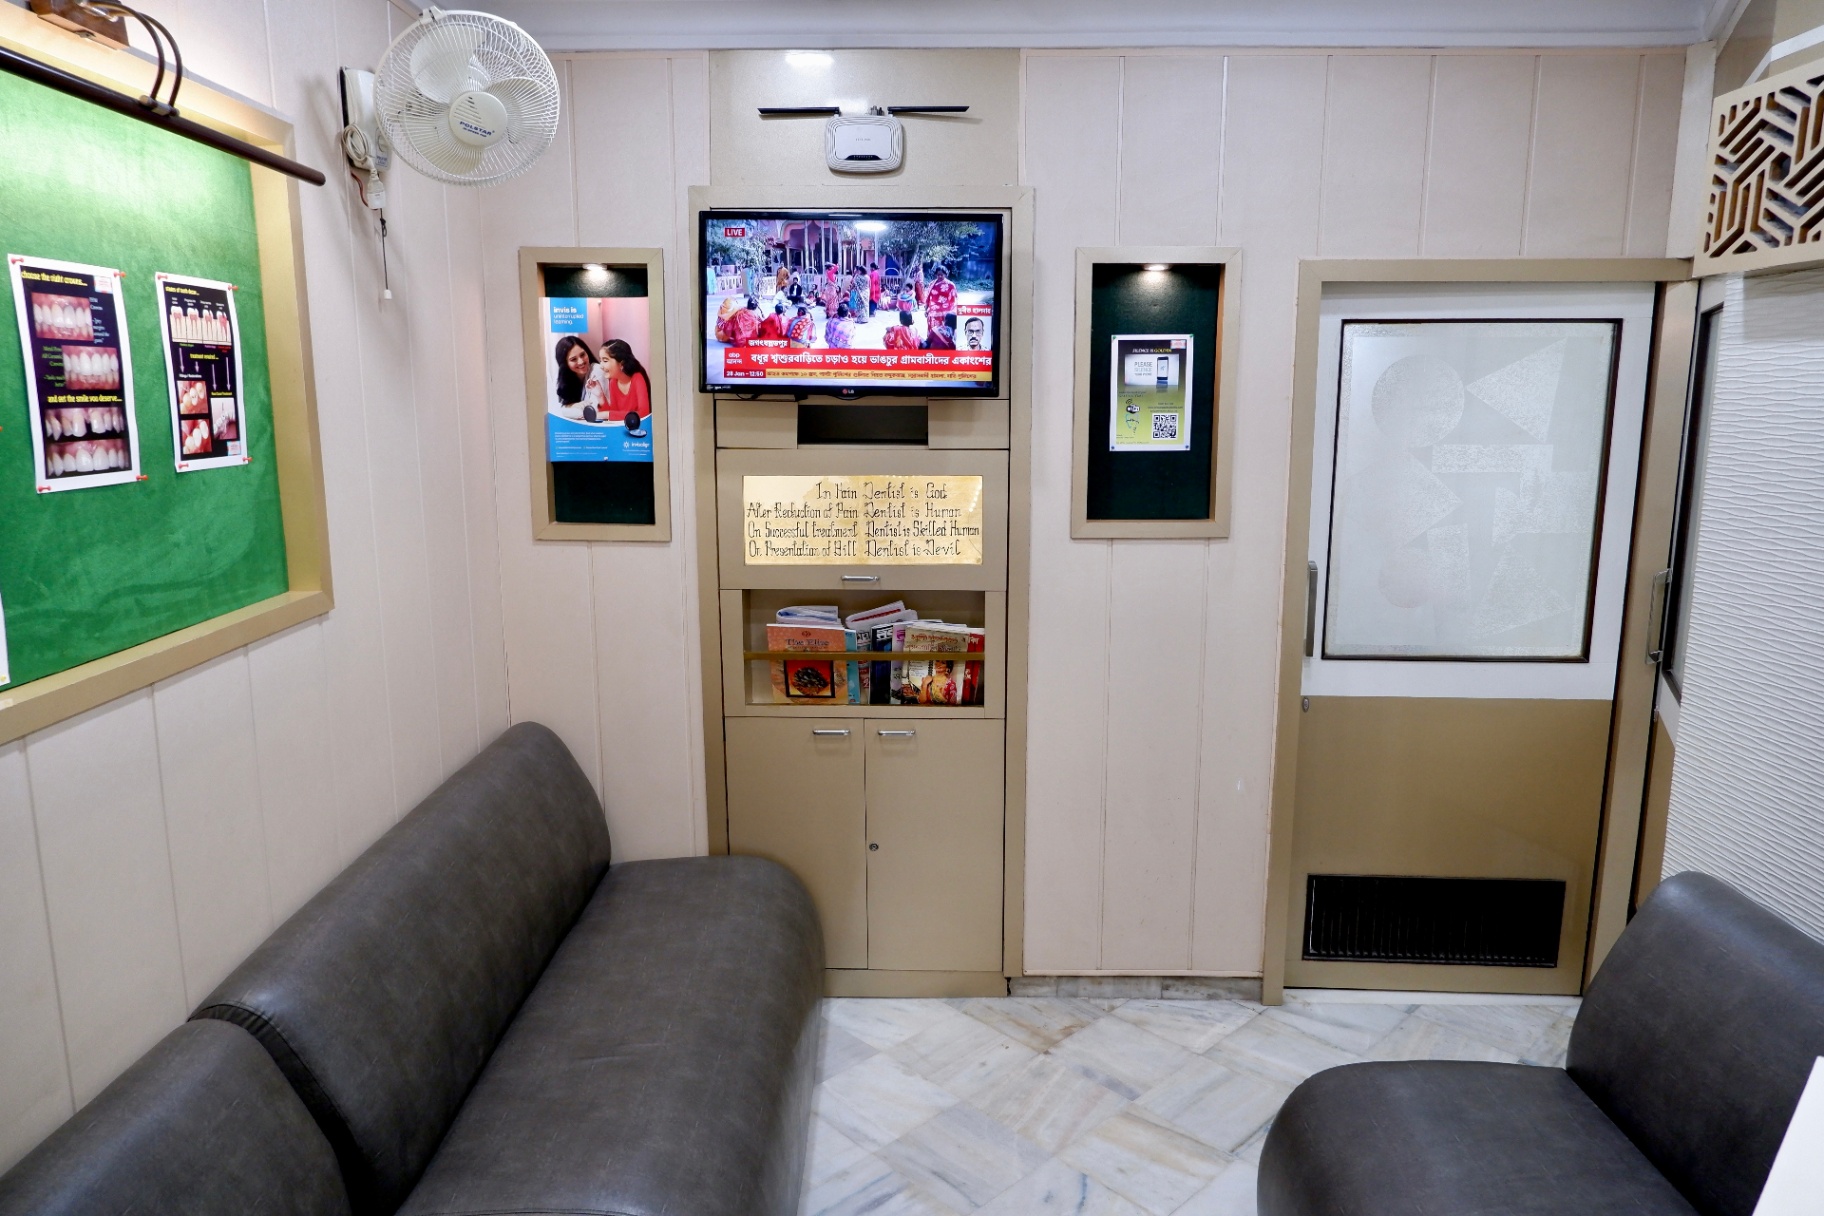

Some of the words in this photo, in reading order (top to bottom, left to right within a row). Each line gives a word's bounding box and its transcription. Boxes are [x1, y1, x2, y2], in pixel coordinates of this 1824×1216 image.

[726, 228, 742, 236] LIVE
[751, 354, 768, 364] বধূর
[826, 354, 848, 365] চড়াও
[851, 355, 867, 364] হয়ে
[870, 356, 898, 366] ভাঙচুর
[901, 353, 950, 365] গ্রামবাসীদের
[952, 356, 992, 366] একাংশের
[816, 482, 831, 499] In
[835, 482, 857, 499] Pain
[863, 482, 905, 499] Dentist
[910, 486, 919, 499] is
[926, 482, 947, 499] God
[746, 502, 772, 518] After
[774, 502, 820, 518] Reduction
[824, 502, 834, 518] of
[836, 502, 858, 518] Pain
[864, 501, 905, 518] Dentist
[911, 506, 919, 518] is
[925, 502, 962, 518] Human
[748, 520, 761, 538] On
[765, 520, 809, 538] Successful
[865, 520, 901, 537] Dentist
[903, 526, 910, 537] is
[913, 520, 946, 537] Skilled
[950, 520, 980, 536] Human
[749, 540, 762, 557] On
[765, 540, 820, 557] Presentation
[822, 540, 831, 556] of
[834, 540, 856, 556] Bill
[864, 540, 909, 557] Dentist
[912, 544, 920, 556] is
[923, 540, 961, 556] Devil
